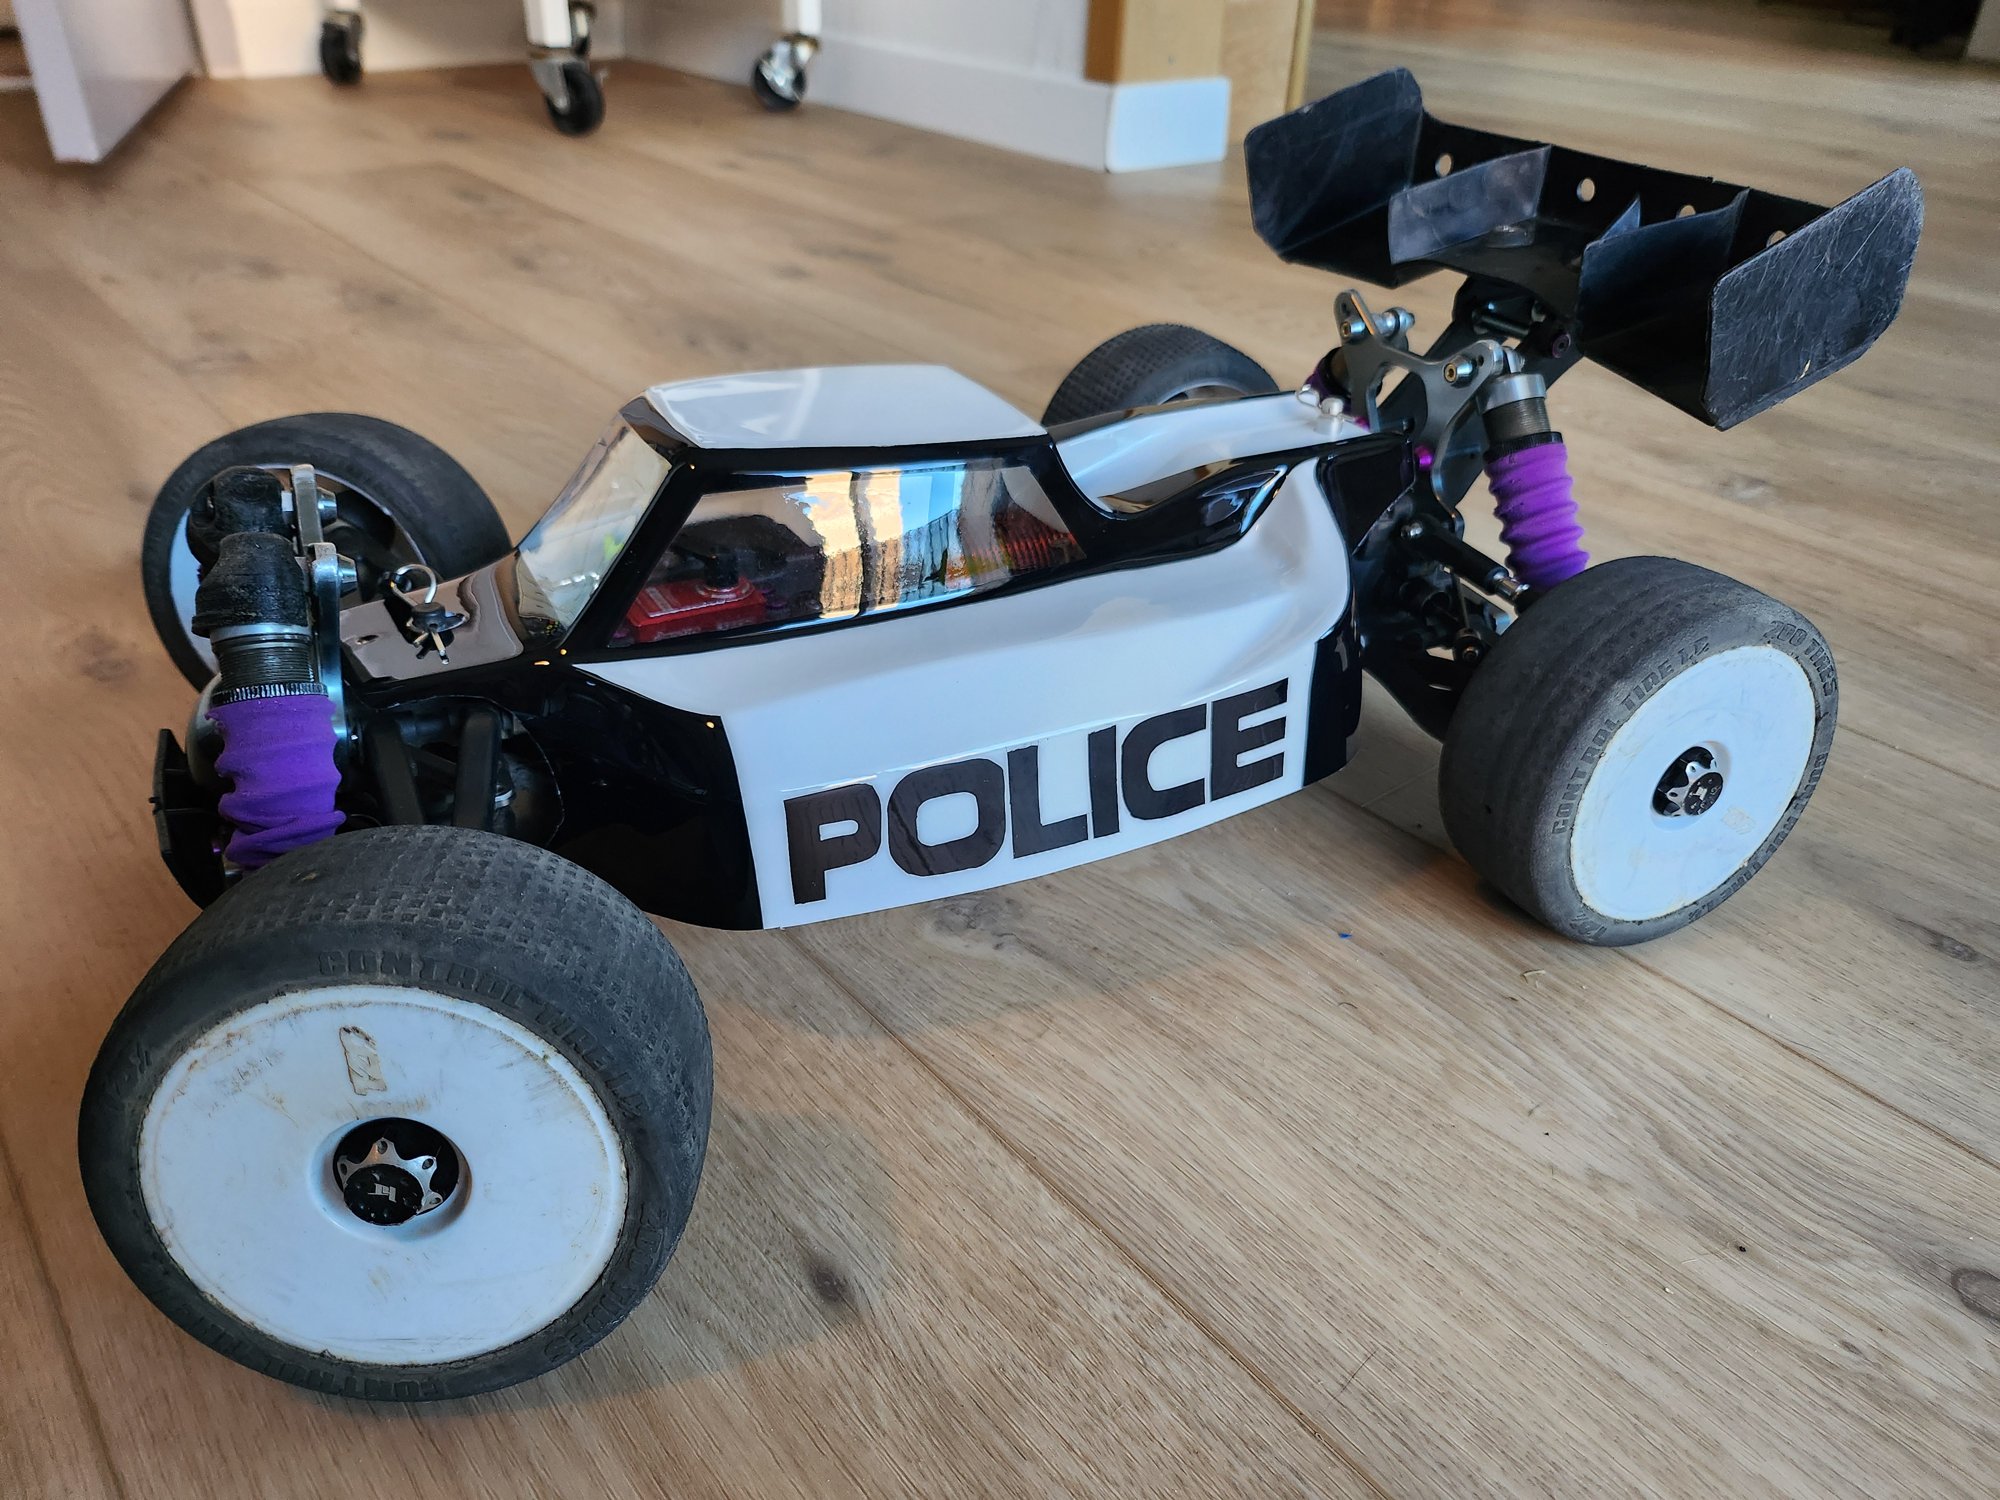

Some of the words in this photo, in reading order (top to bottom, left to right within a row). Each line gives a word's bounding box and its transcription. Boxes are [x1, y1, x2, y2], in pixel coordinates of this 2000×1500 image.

[783, 677, 1289, 905] POLICE
[1552, 718, 1620, 835] CONTROL
[1621, 658, 1675, 711] TIRE
